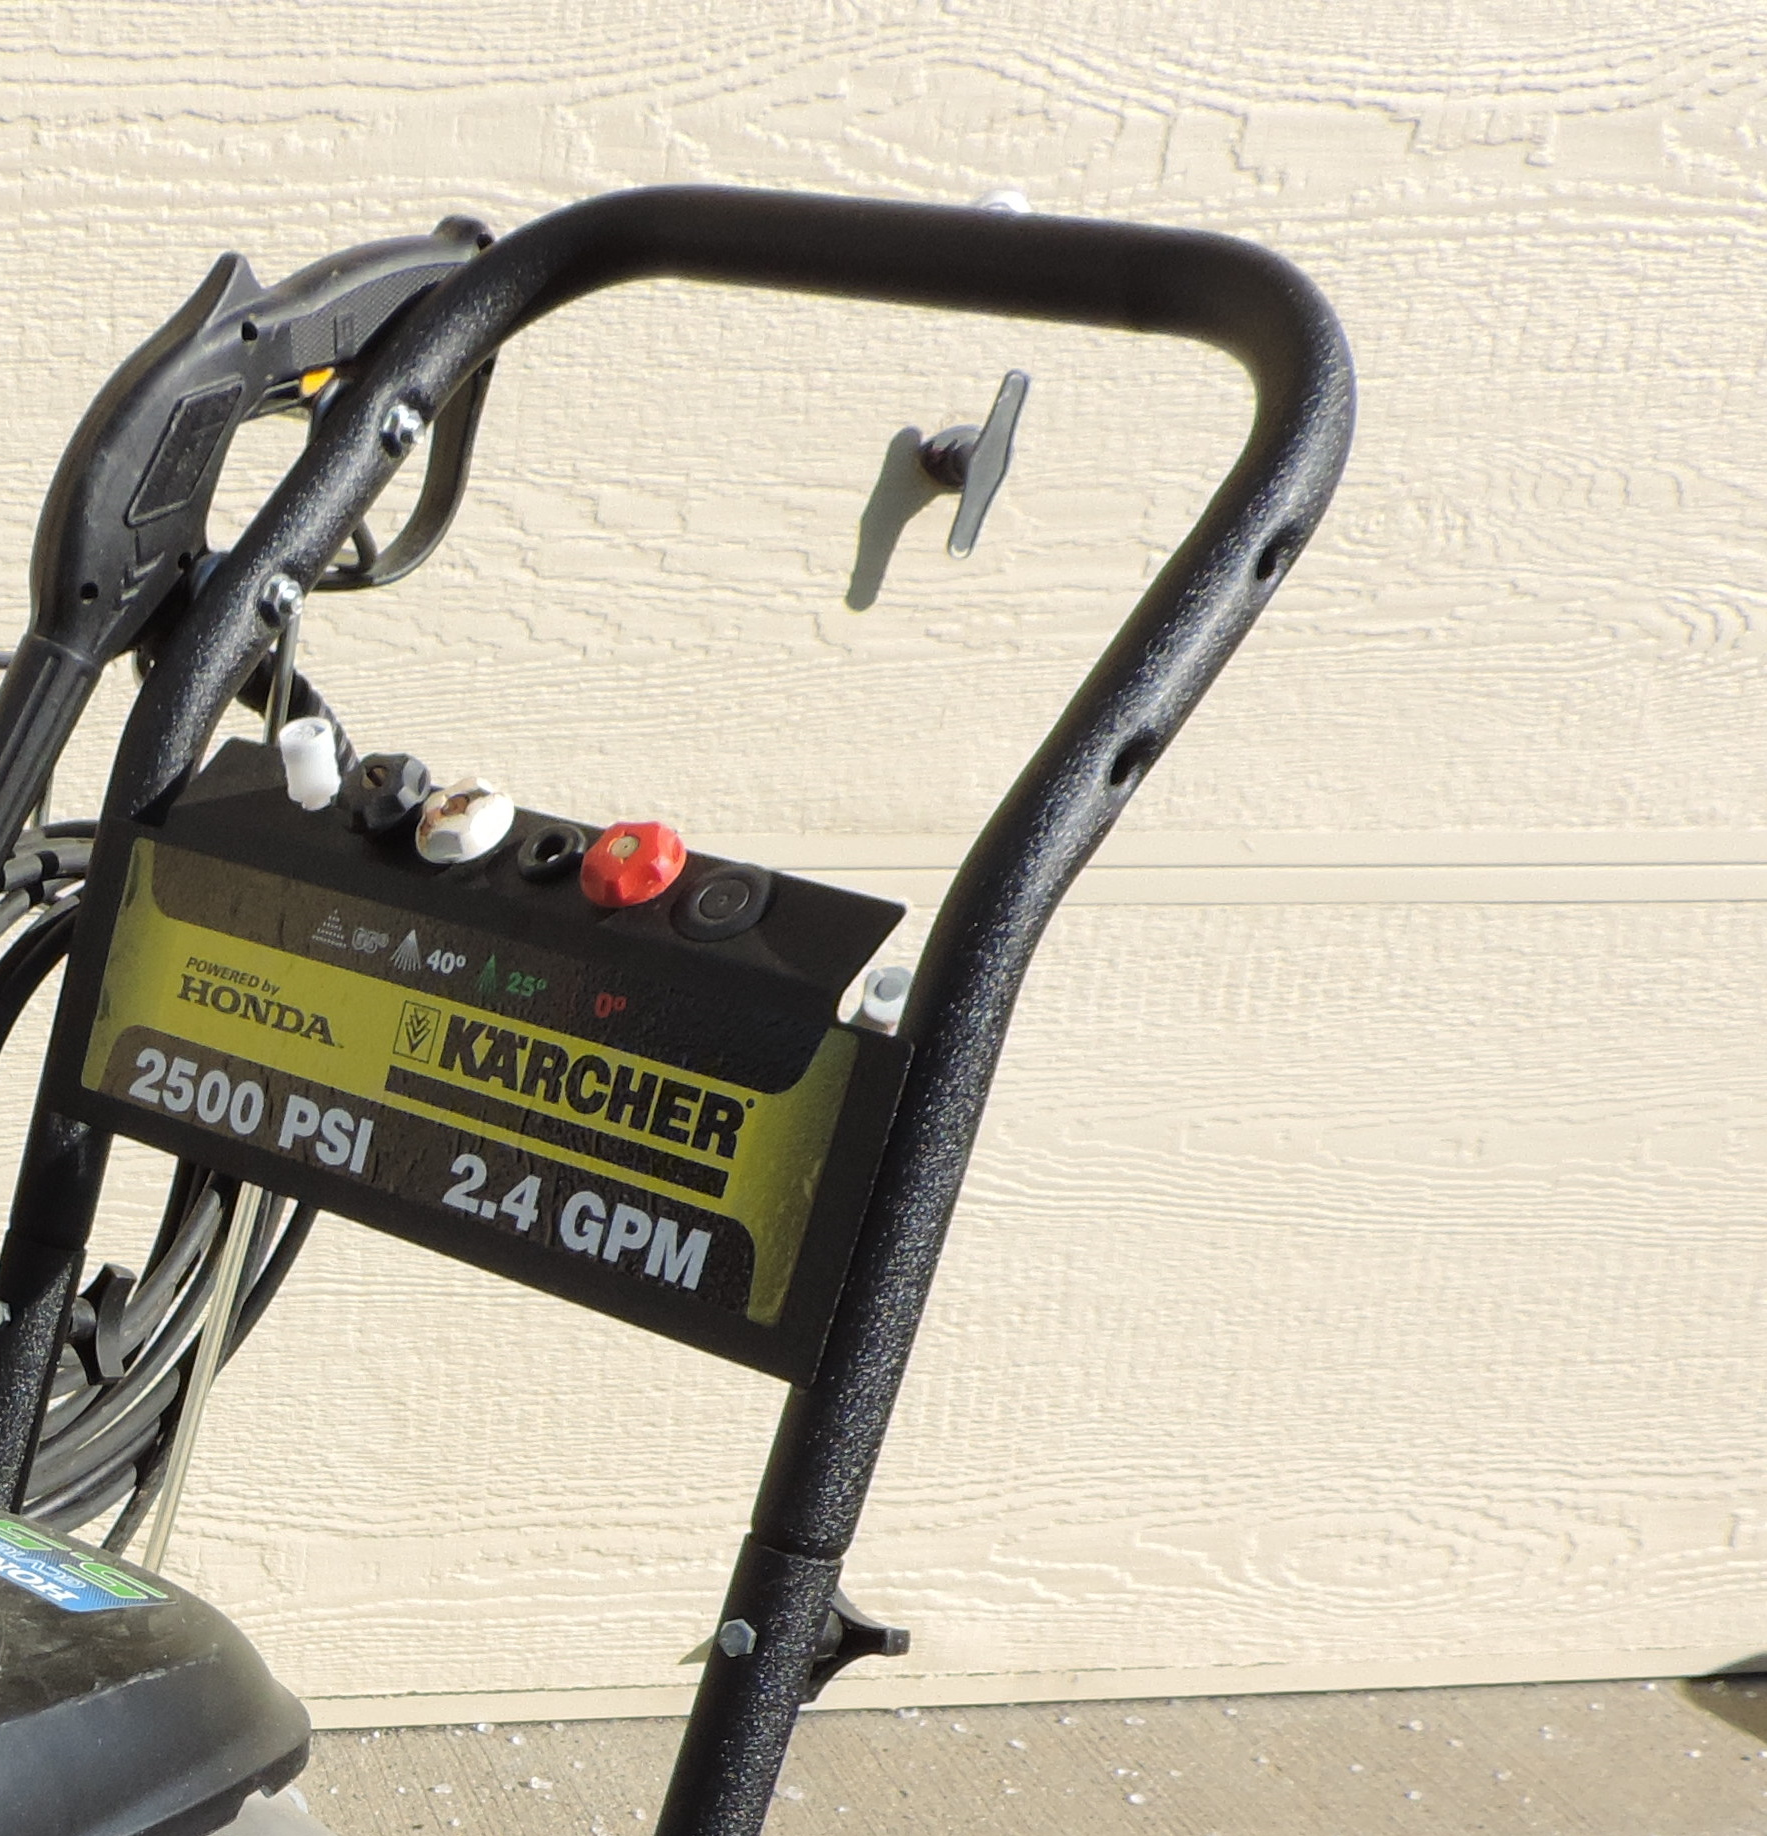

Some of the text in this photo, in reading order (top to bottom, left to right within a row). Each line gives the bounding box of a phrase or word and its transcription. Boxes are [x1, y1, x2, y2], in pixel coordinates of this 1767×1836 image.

[176, 974, 336, 1048] HONDA
[185, 956, 281, 997] POWERED by
[129, 1048, 376, 1178] 2500 PSI
[437, 1013, 745, 1160] KÄRCHER
[441, 1154, 713, 1292] 2.4 GPM
